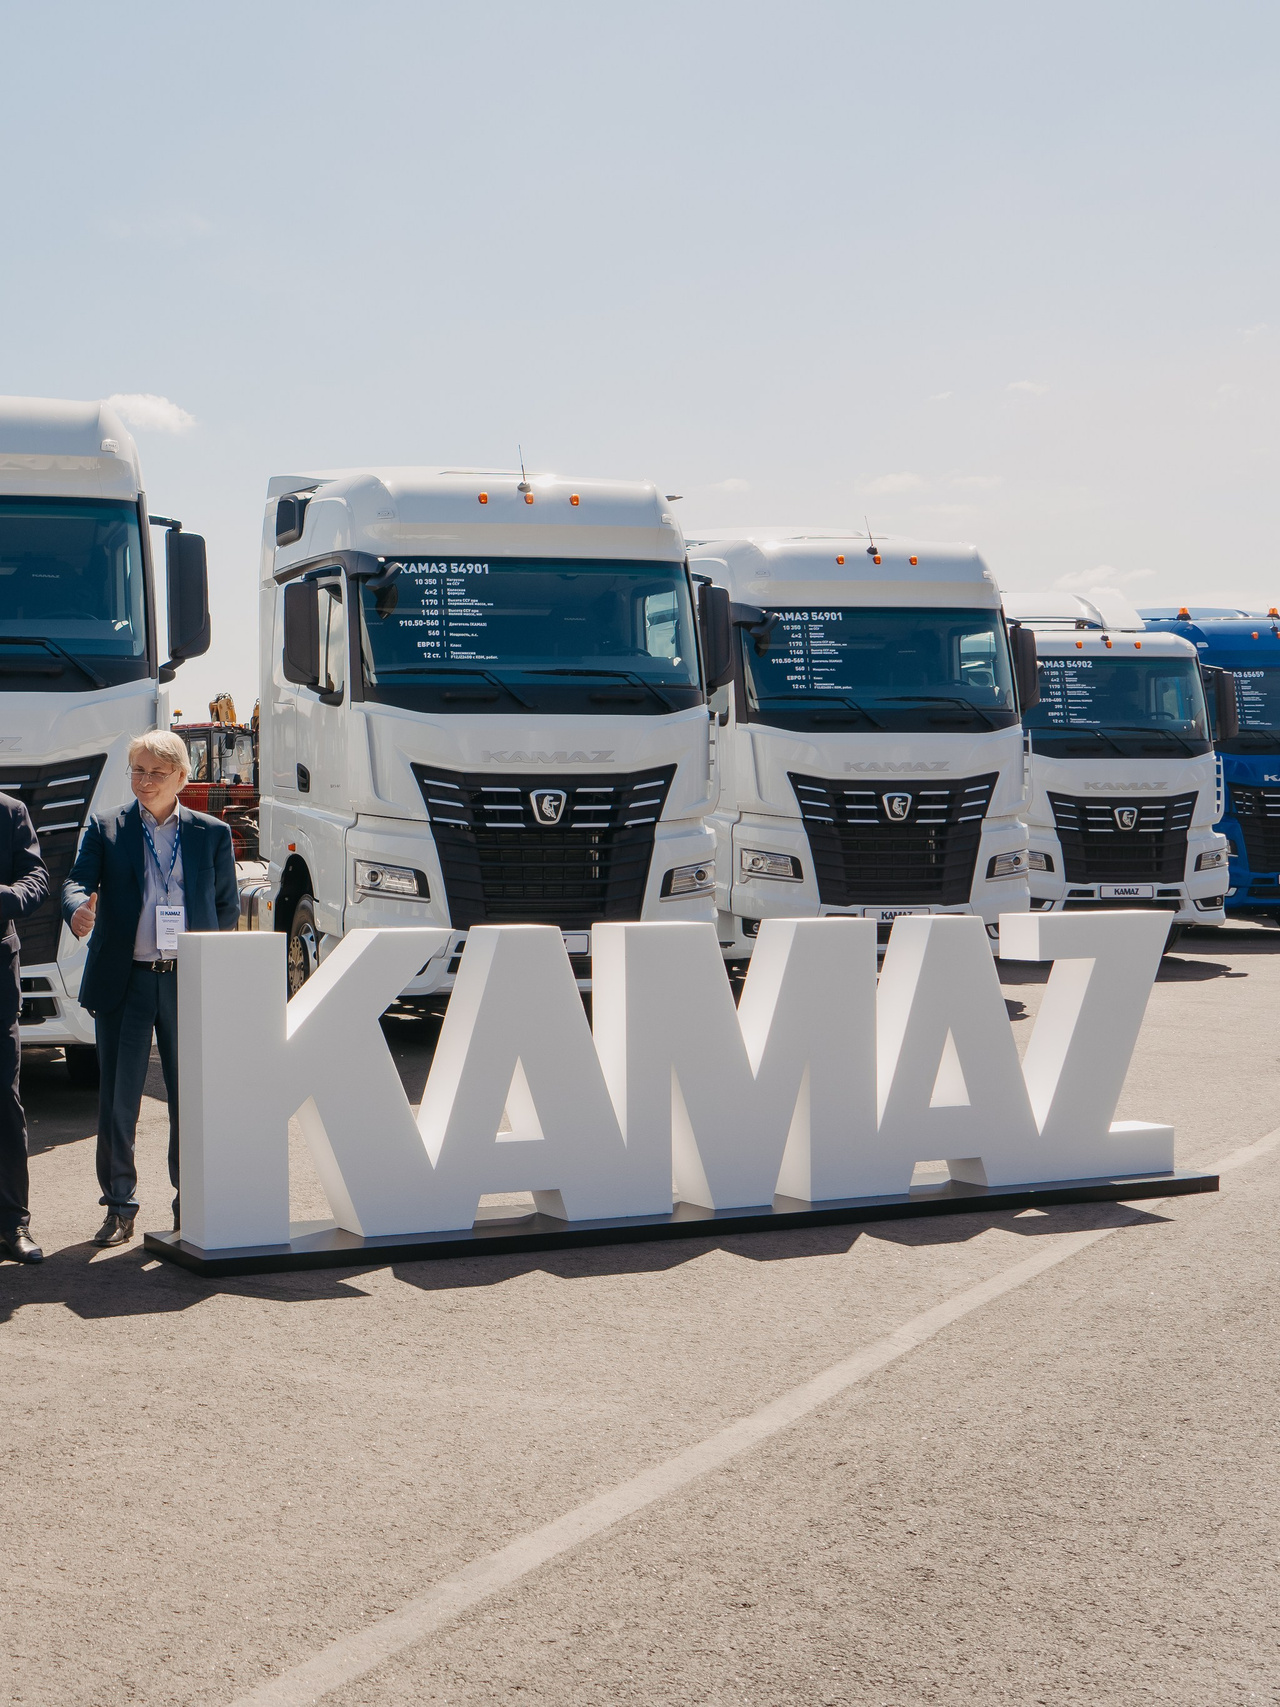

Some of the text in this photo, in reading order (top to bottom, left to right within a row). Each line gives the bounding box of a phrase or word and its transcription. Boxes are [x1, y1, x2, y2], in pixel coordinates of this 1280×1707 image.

[450, 563, 489, 574] 54901
[779, 612, 842, 621] АМАЗ 54901
[482, 750, 615, 764] KAMAZ
[844, 761, 950, 772] KAMAZ
[1084, 781, 1168, 790] KAMAZ
[178, 911, 1174, 1250] KAMAZ
